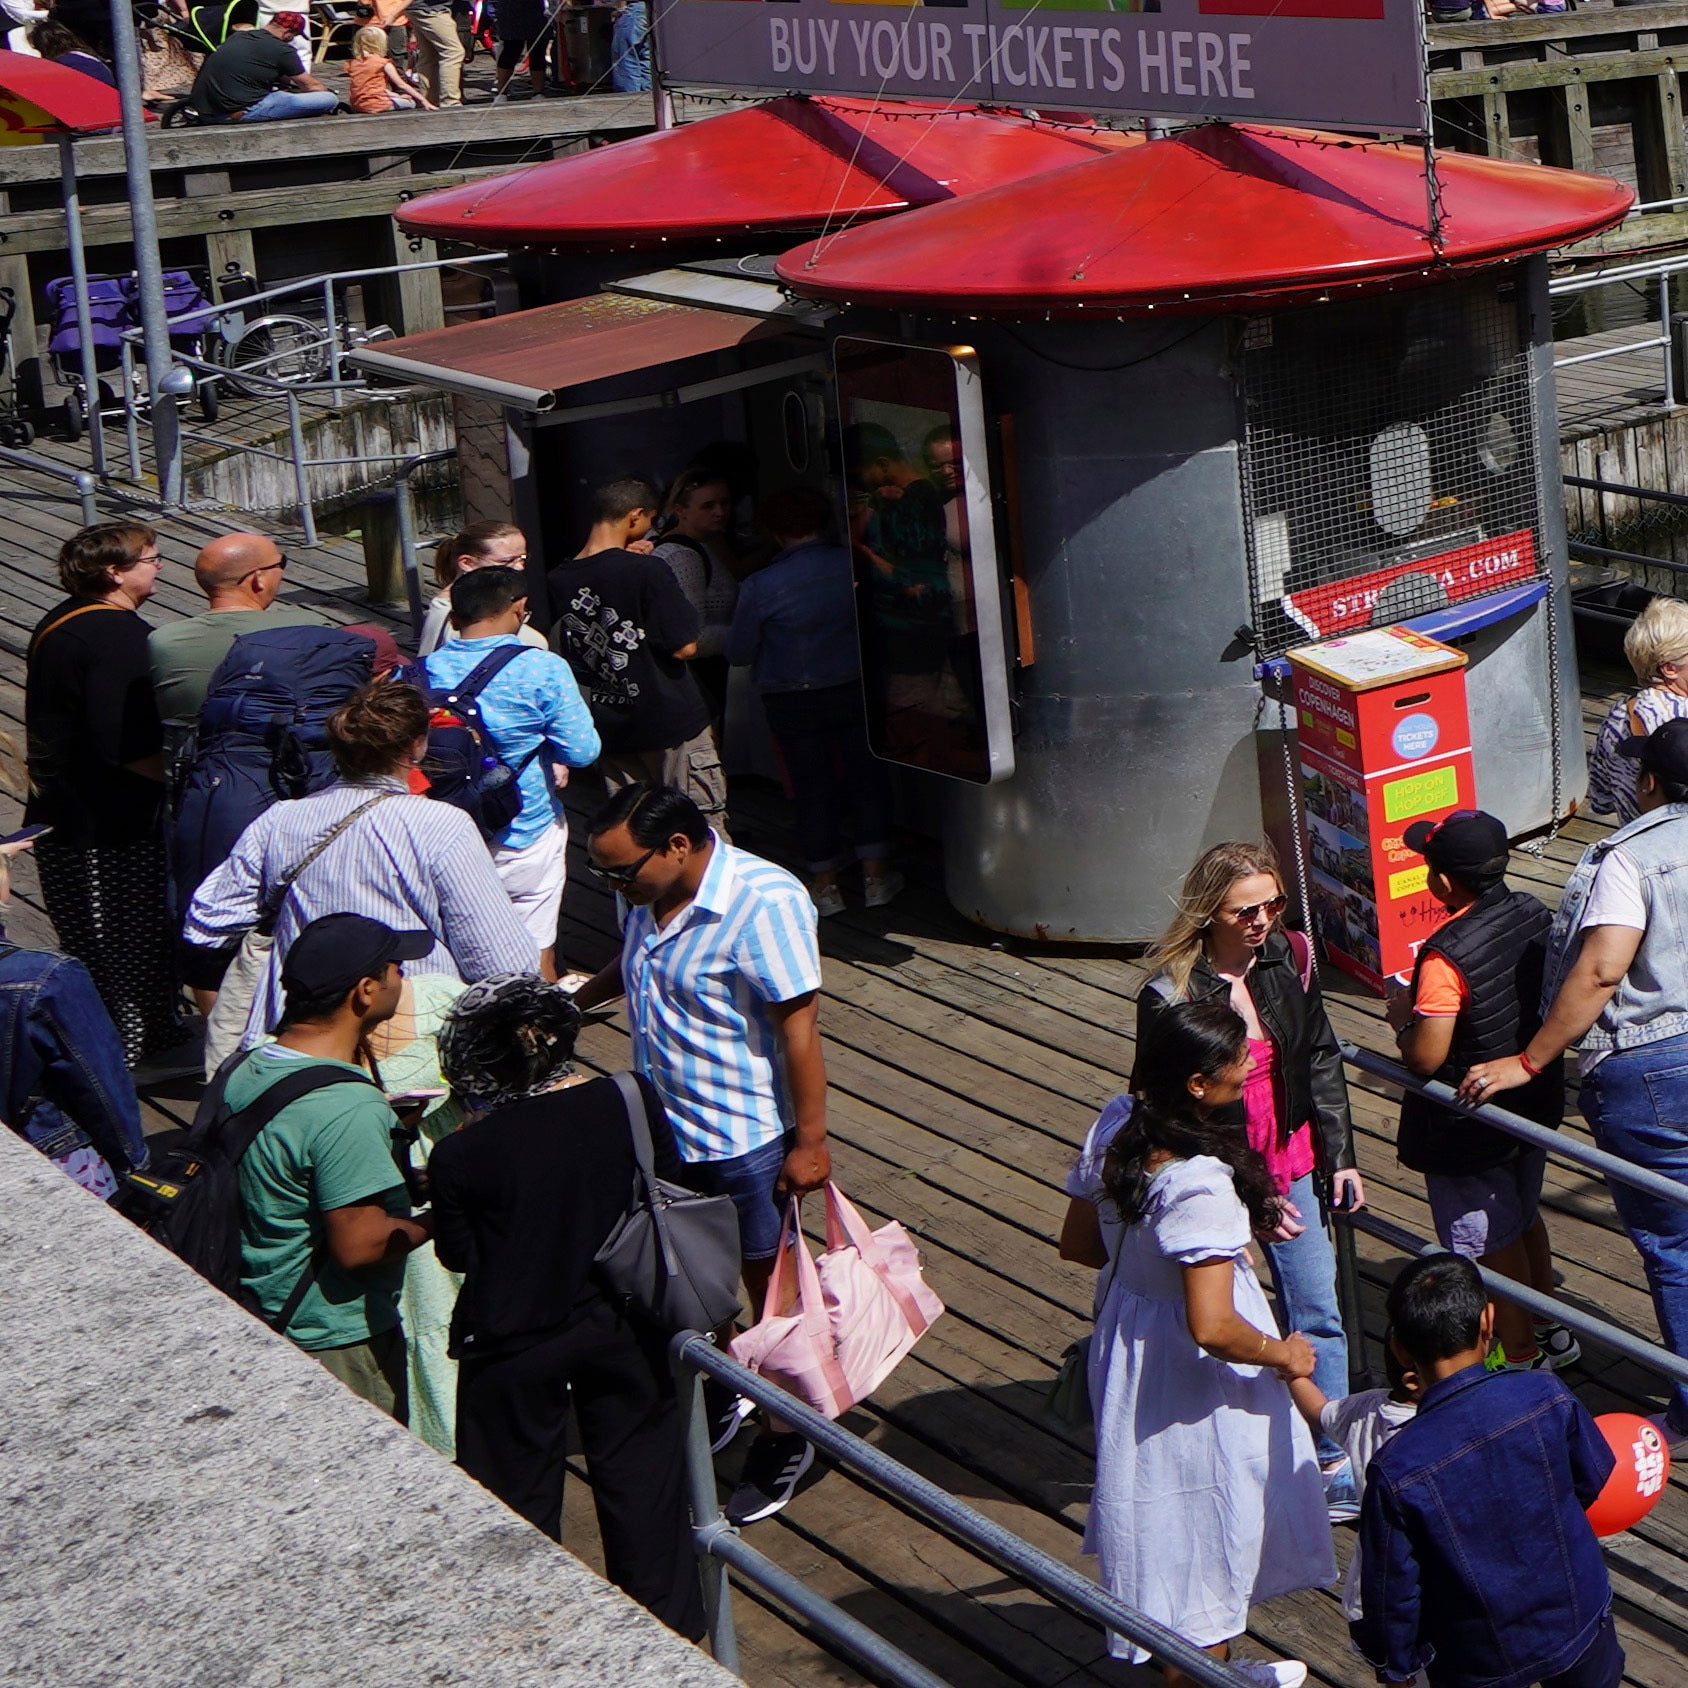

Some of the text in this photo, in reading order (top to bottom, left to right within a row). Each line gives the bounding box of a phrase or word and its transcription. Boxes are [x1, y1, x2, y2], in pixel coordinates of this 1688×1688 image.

[770, 18, 1256, 99] BUY YOUR TICKETS HERE
[1308, 676, 1341, 700] DISCOVER
[1299, 688, 1355, 729] COPENHAGEN
[1397, 731, 1434, 743] TICKETS
[1403, 740, 1427, 750] HERE
[1395, 775, 1444, 799] HOP ON
[1395, 787, 1448, 812] HOP OFF
